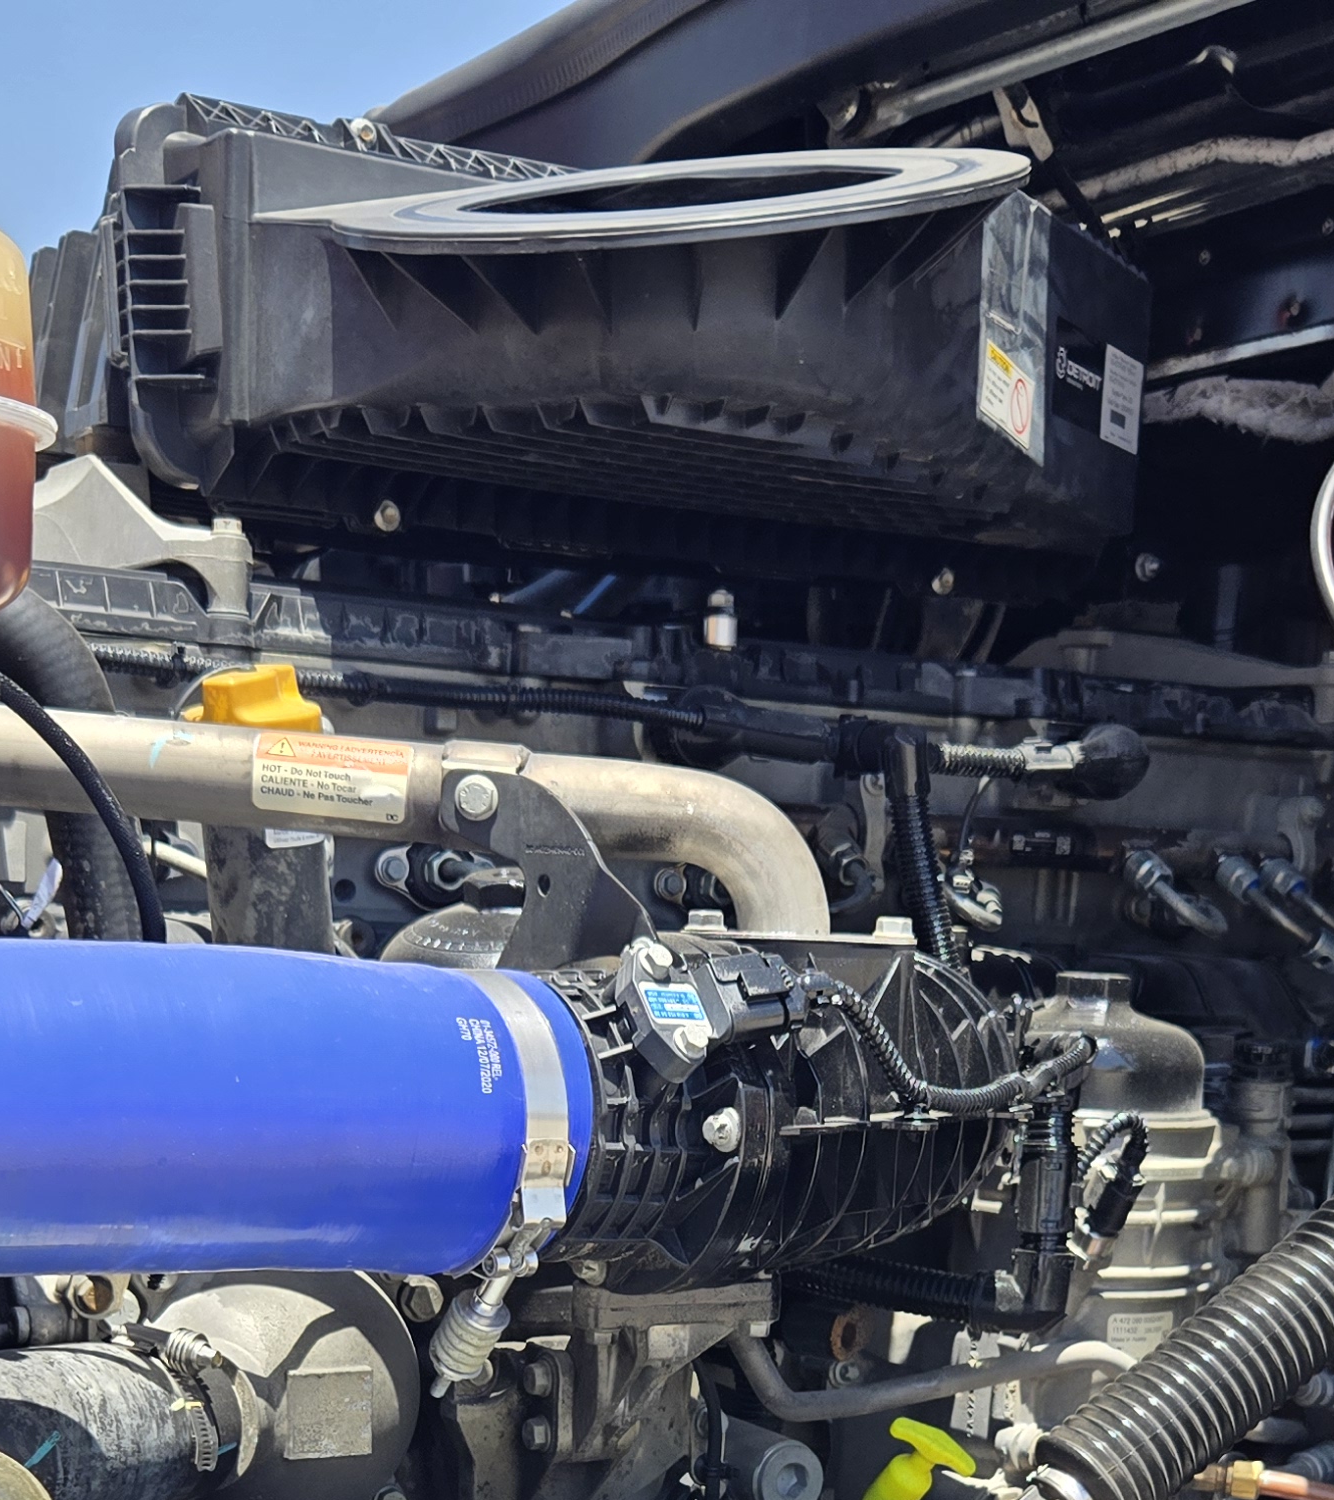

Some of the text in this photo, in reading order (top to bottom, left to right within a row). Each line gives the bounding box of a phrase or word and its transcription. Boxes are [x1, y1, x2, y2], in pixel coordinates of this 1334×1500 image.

[1067, 359, 1103, 392] DETROIT
[262, 764, 351, 782] HOT Do Not Touch
[261, 775, 357, 793] CALIENTE No Tocar
[260, 786, 373, 807] CHAUD Ne Pas Toucher
[468, 1018, 493, 1094] CHINA 12/07/2020
